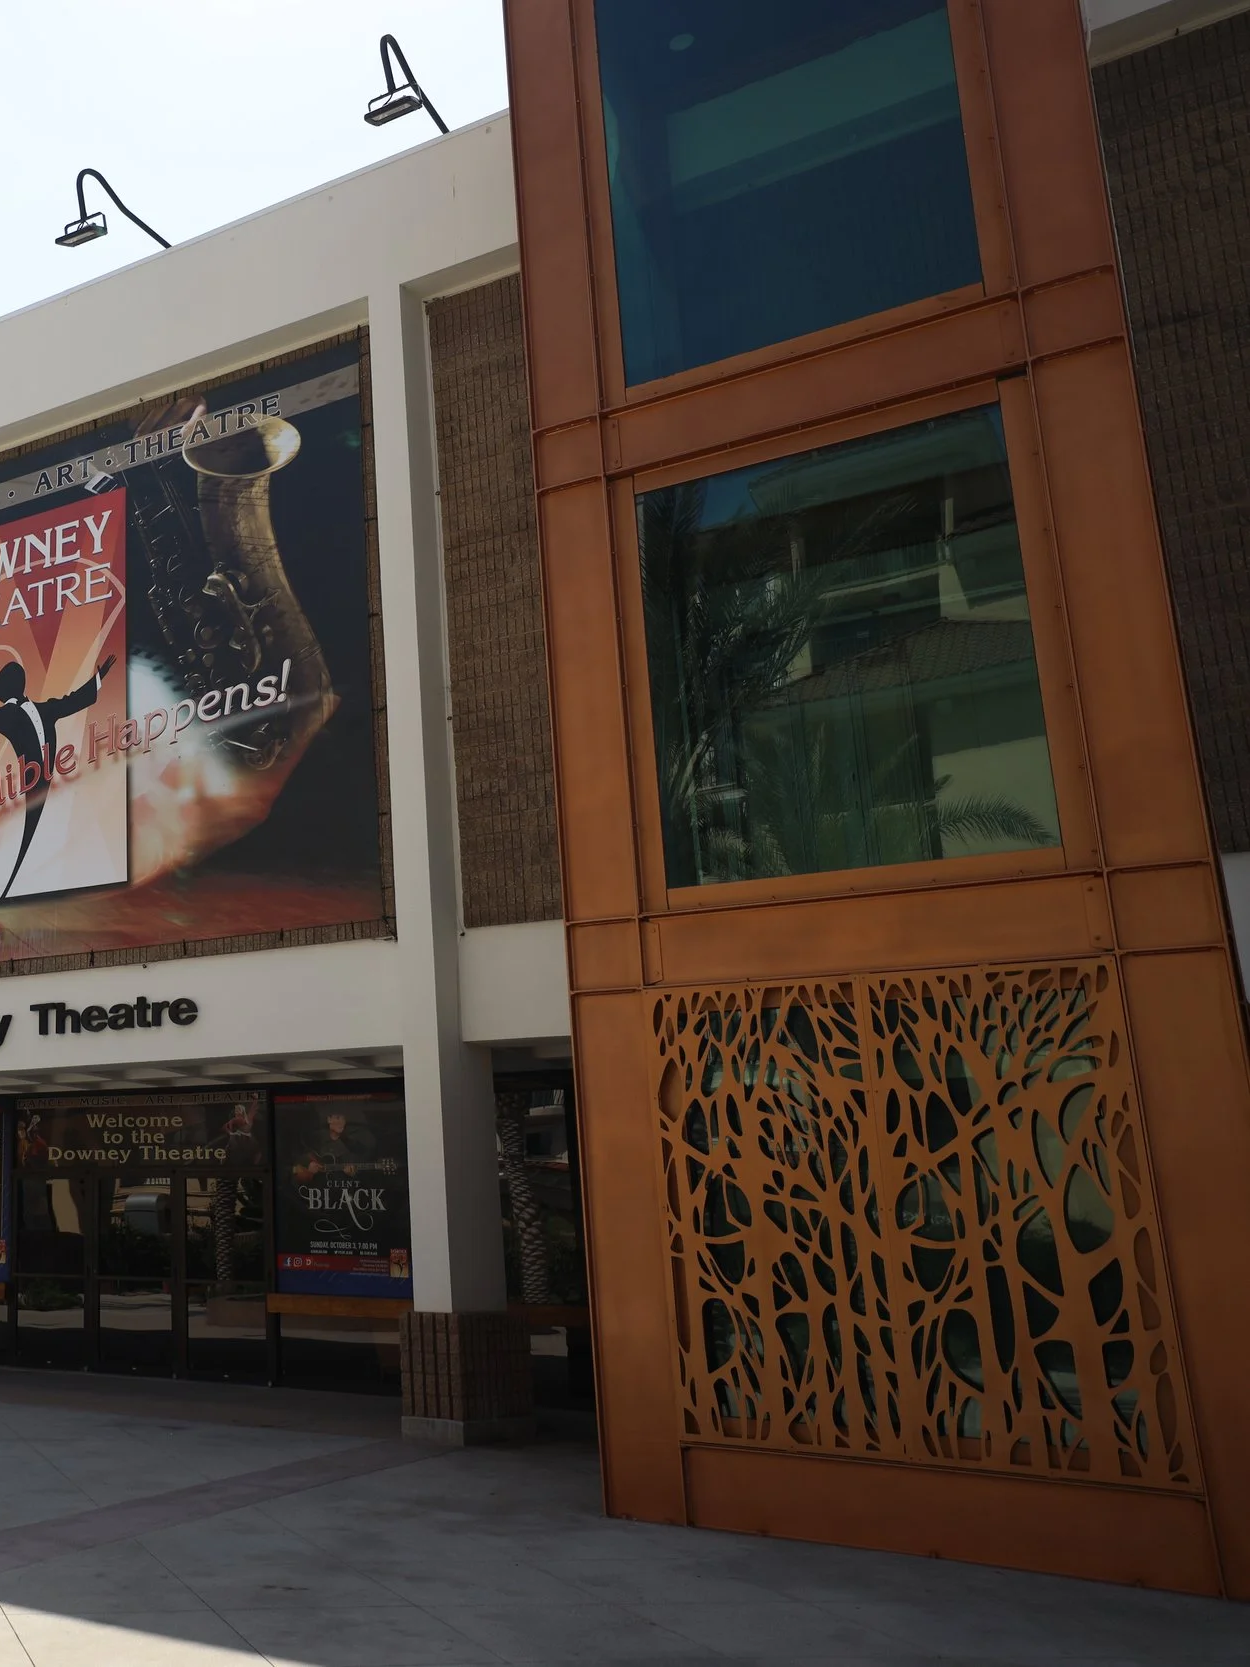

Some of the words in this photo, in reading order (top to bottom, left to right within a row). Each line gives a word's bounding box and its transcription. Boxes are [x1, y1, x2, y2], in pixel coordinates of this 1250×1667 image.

[33, 455, 95, 496] ART
[124, 392, 283, 465] THEATRE
[87, 658, 292, 765] Happens!
[30, 996, 199, 1036] Theatre
[79, 1096, 129, 1107] MUSIC
[145, 1095, 177, 1105] ART
[86, 1113, 183, 1129] Welcome
[103, 1130, 124, 1145] to
[132, 1129, 166, 1145] the
[48, 1146, 132, 1164] Downey
[139, 1145, 227, 1161] Theatre
[327, 1180, 361, 1188] CLINT
[300, 1186, 388, 1214] BLACK
[329, 1241, 352, 1249] OCTOBER
